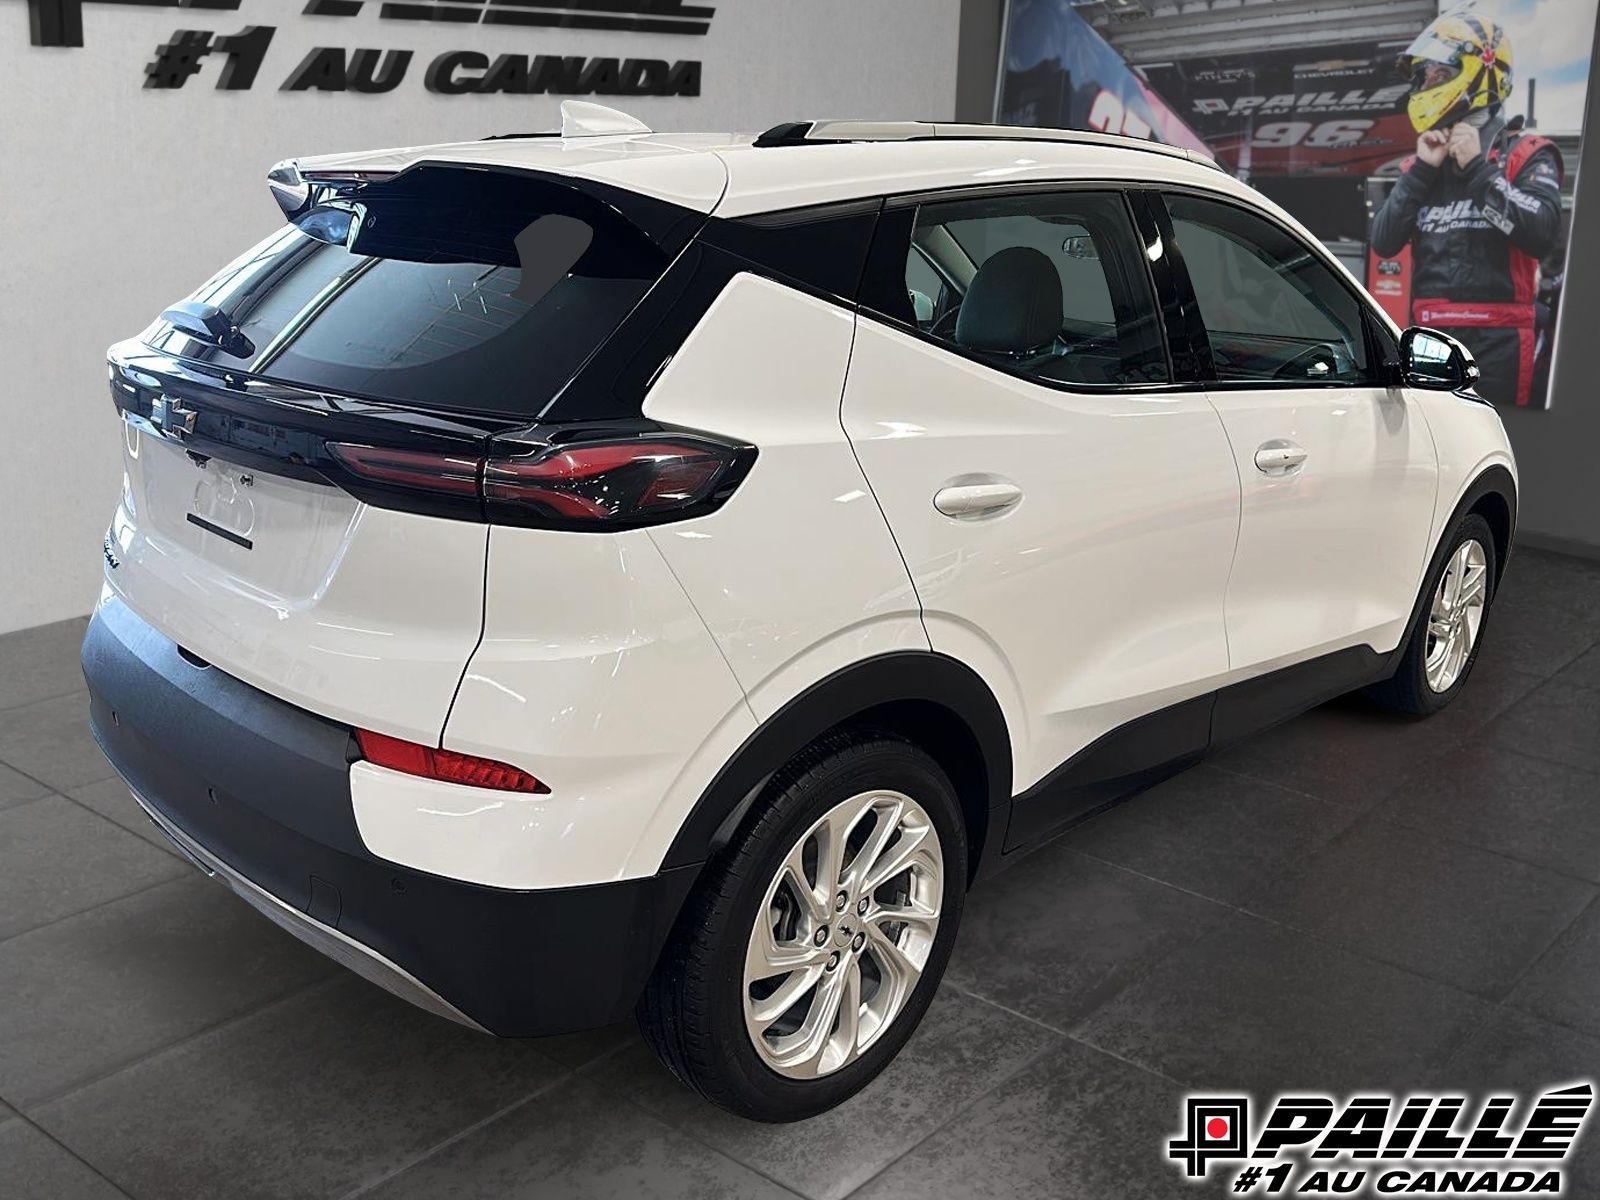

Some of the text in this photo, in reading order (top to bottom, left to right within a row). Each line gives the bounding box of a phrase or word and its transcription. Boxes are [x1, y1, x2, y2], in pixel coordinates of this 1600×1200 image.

[142, 25, 702, 97] #1 AU CANADA
[1296, 102, 1396, 112] CANADA
[1251, 118, 1375, 148] 96
